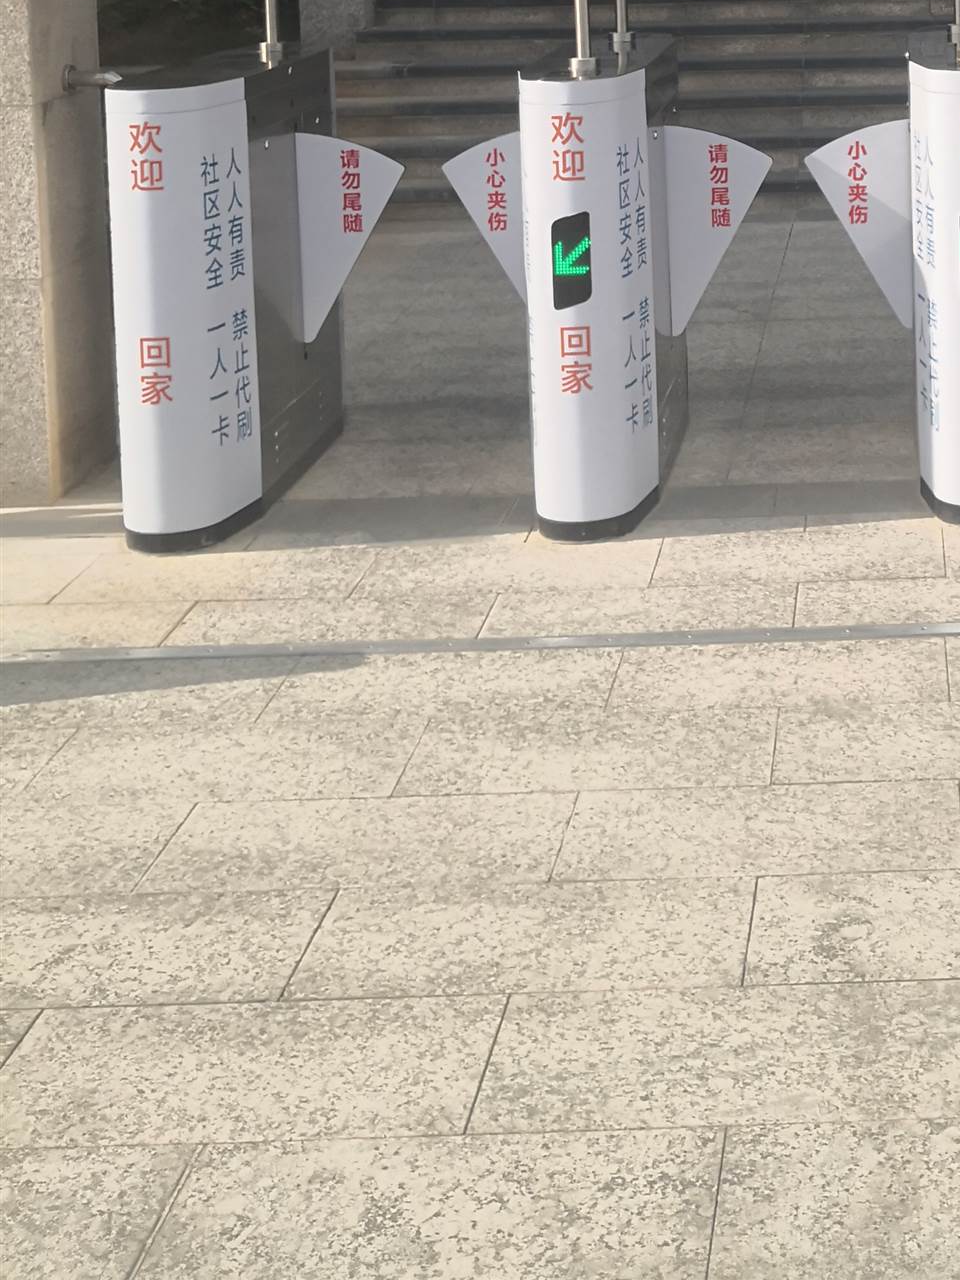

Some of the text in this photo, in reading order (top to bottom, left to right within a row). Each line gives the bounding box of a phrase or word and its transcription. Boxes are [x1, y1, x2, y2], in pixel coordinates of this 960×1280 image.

[128, 122, 165, 193] 欢迎
[551, 111, 586, 183] 欢迎
[708, 143, 731, 228] 请勿尾随
[848, 141, 868, 225] 小心夹伤
[200, 153, 224, 290] 社区安全
[226, 147, 245, 281] 人人有责
[340, 149, 363, 233] 请勿尾随
[486, 148, 507, 232] 小心夹伤
[616, 144, 633, 278] 社区安全
[633, 137, 647, 269] 人人有责
[138, 337, 173, 405] 回家
[207, 322, 230, 446] 一人一卡
[233, 308, 252, 442] 禁止代刷
[559, 326, 593, 395] 回家
[623, 311, 638, 434] 一人一卡
